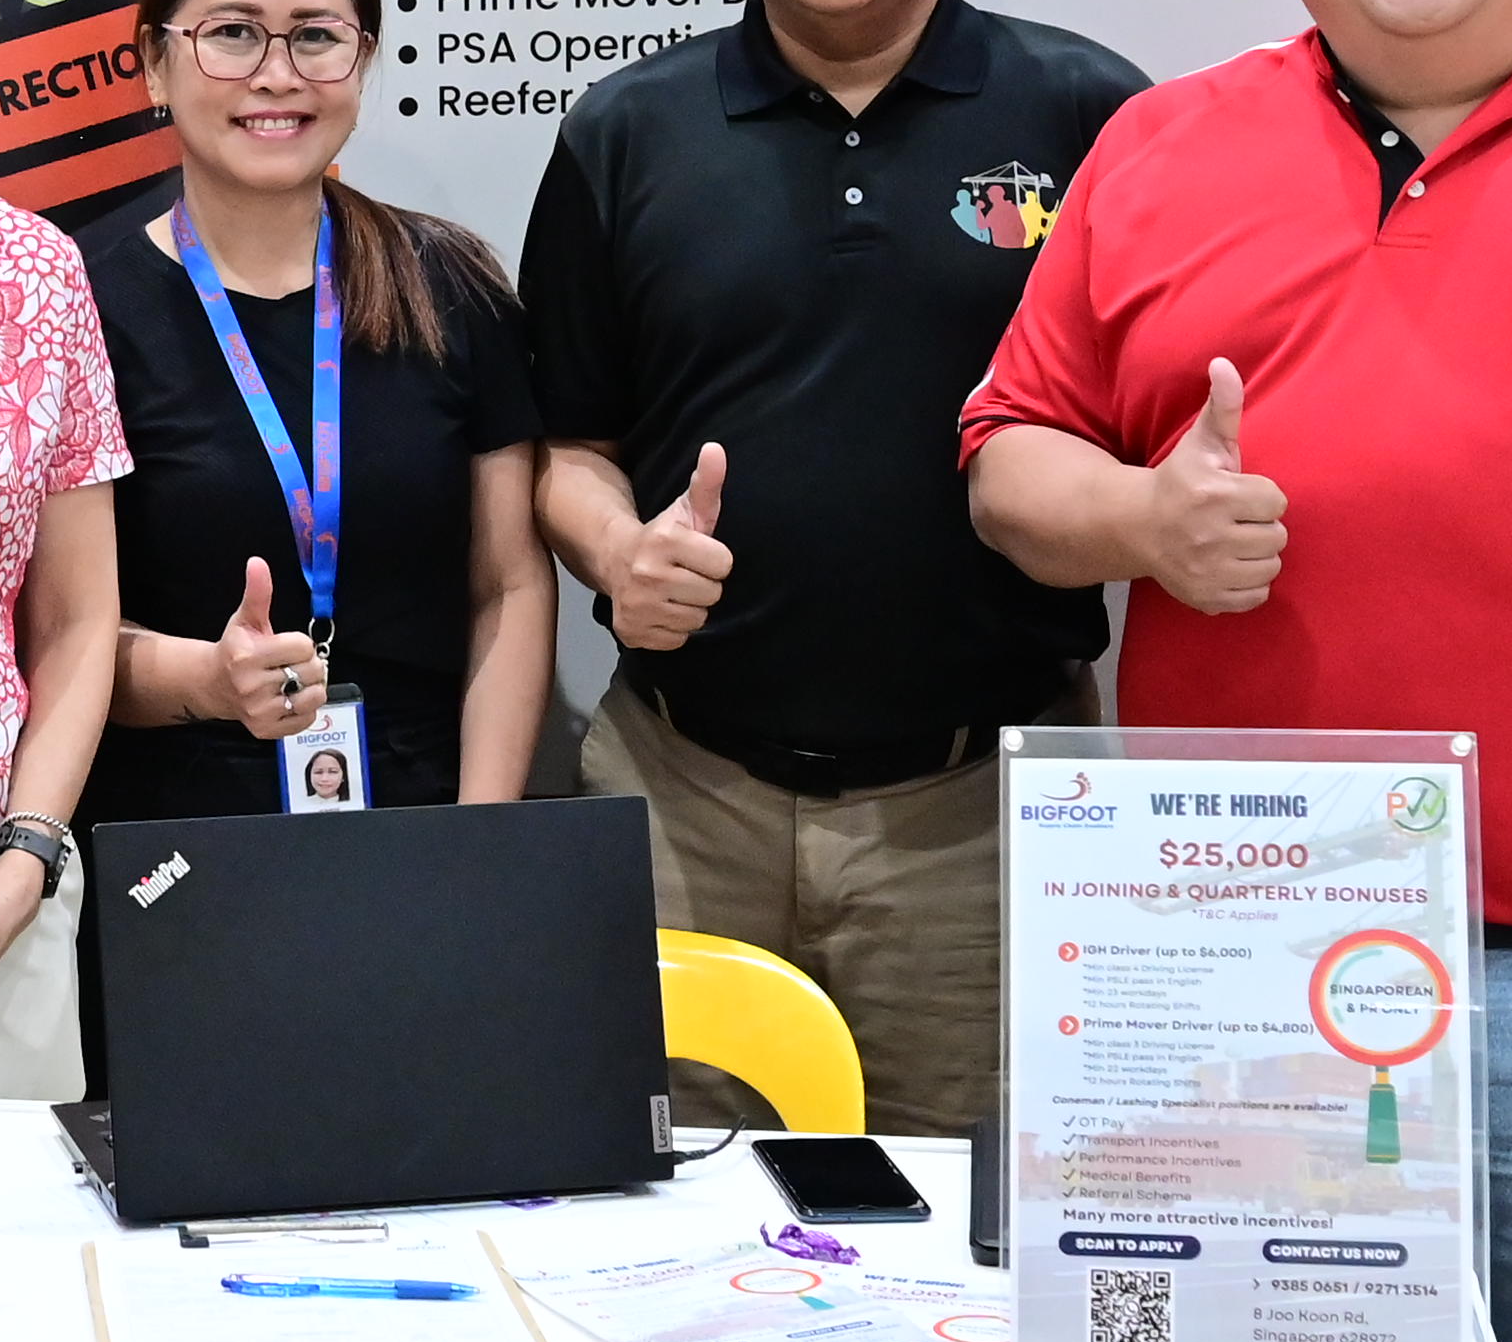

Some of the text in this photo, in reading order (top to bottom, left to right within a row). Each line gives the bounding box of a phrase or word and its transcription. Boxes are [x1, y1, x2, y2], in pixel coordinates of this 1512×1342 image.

[438, 32, 516, 65] PSA
[439, 81, 573, 116] Reefer
[297, 731, 348, 745] BIGFOOT
[1021, 805, 1118, 822] BIGFOOT
[1150, 793, 1308, 818] WE'RE HIRING
[1159, 838, 1309, 872] $25,000
[128, 851, 191, 909] ThinkPad
[1044, 882, 1428, 904] IN JOINING & QUARTERLY BONUSES
[1229, 910, 1278, 922] Applies
[1083, 945, 1107, 956] IGH
[1110, 945, 1151, 957] Driver
[1156, 947, 1179, 959] (up
[1182, 948, 1196, 958] to
[1330, 985, 1433, 996] SINGAPOREAN
[1083, 1018, 1122, 1029] Prime
[1126, 1019, 1168, 1031] Mover
[1172, 1020, 1213, 1031] Driver
[1218, 1022, 1241, 1034] (up
[1244, 1023, 1258, 1032] to
[1053, 1095, 1348, 1112] Coneman Lashing Specialist positions are available!
[657, 1100, 669, 1148] Lenovo
[1079, 1118, 1125, 1131] OT Pay
[1079, 1136, 1220, 1150] Transport Incentives
[1079, 1153, 1242, 1168] Performance Incentives
[1079, 1170, 1192, 1185] Medical Benefits
[1079, 1187, 1192, 1202] Referral Scheme
[1063, 1209, 1334, 1230] Many more attractive incentives!
[1075, 1237, 1184, 1254] SCAN TO APPLY
[1269, 1244, 1401, 1261] CONTACT US NOW
[1271, 1279, 1309, 1292] 9385
[1312, 1281, 1348, 1293] 0651
[1364, 1283, 1399, 1295] 9271
[1403, 1284, 1438, 1296] 3514
[1253, 1308, 1262, 1320] 8
[1266, 1309, 1294, 1321] Joo
[1298, 1310, 1340, 1323] Koon
